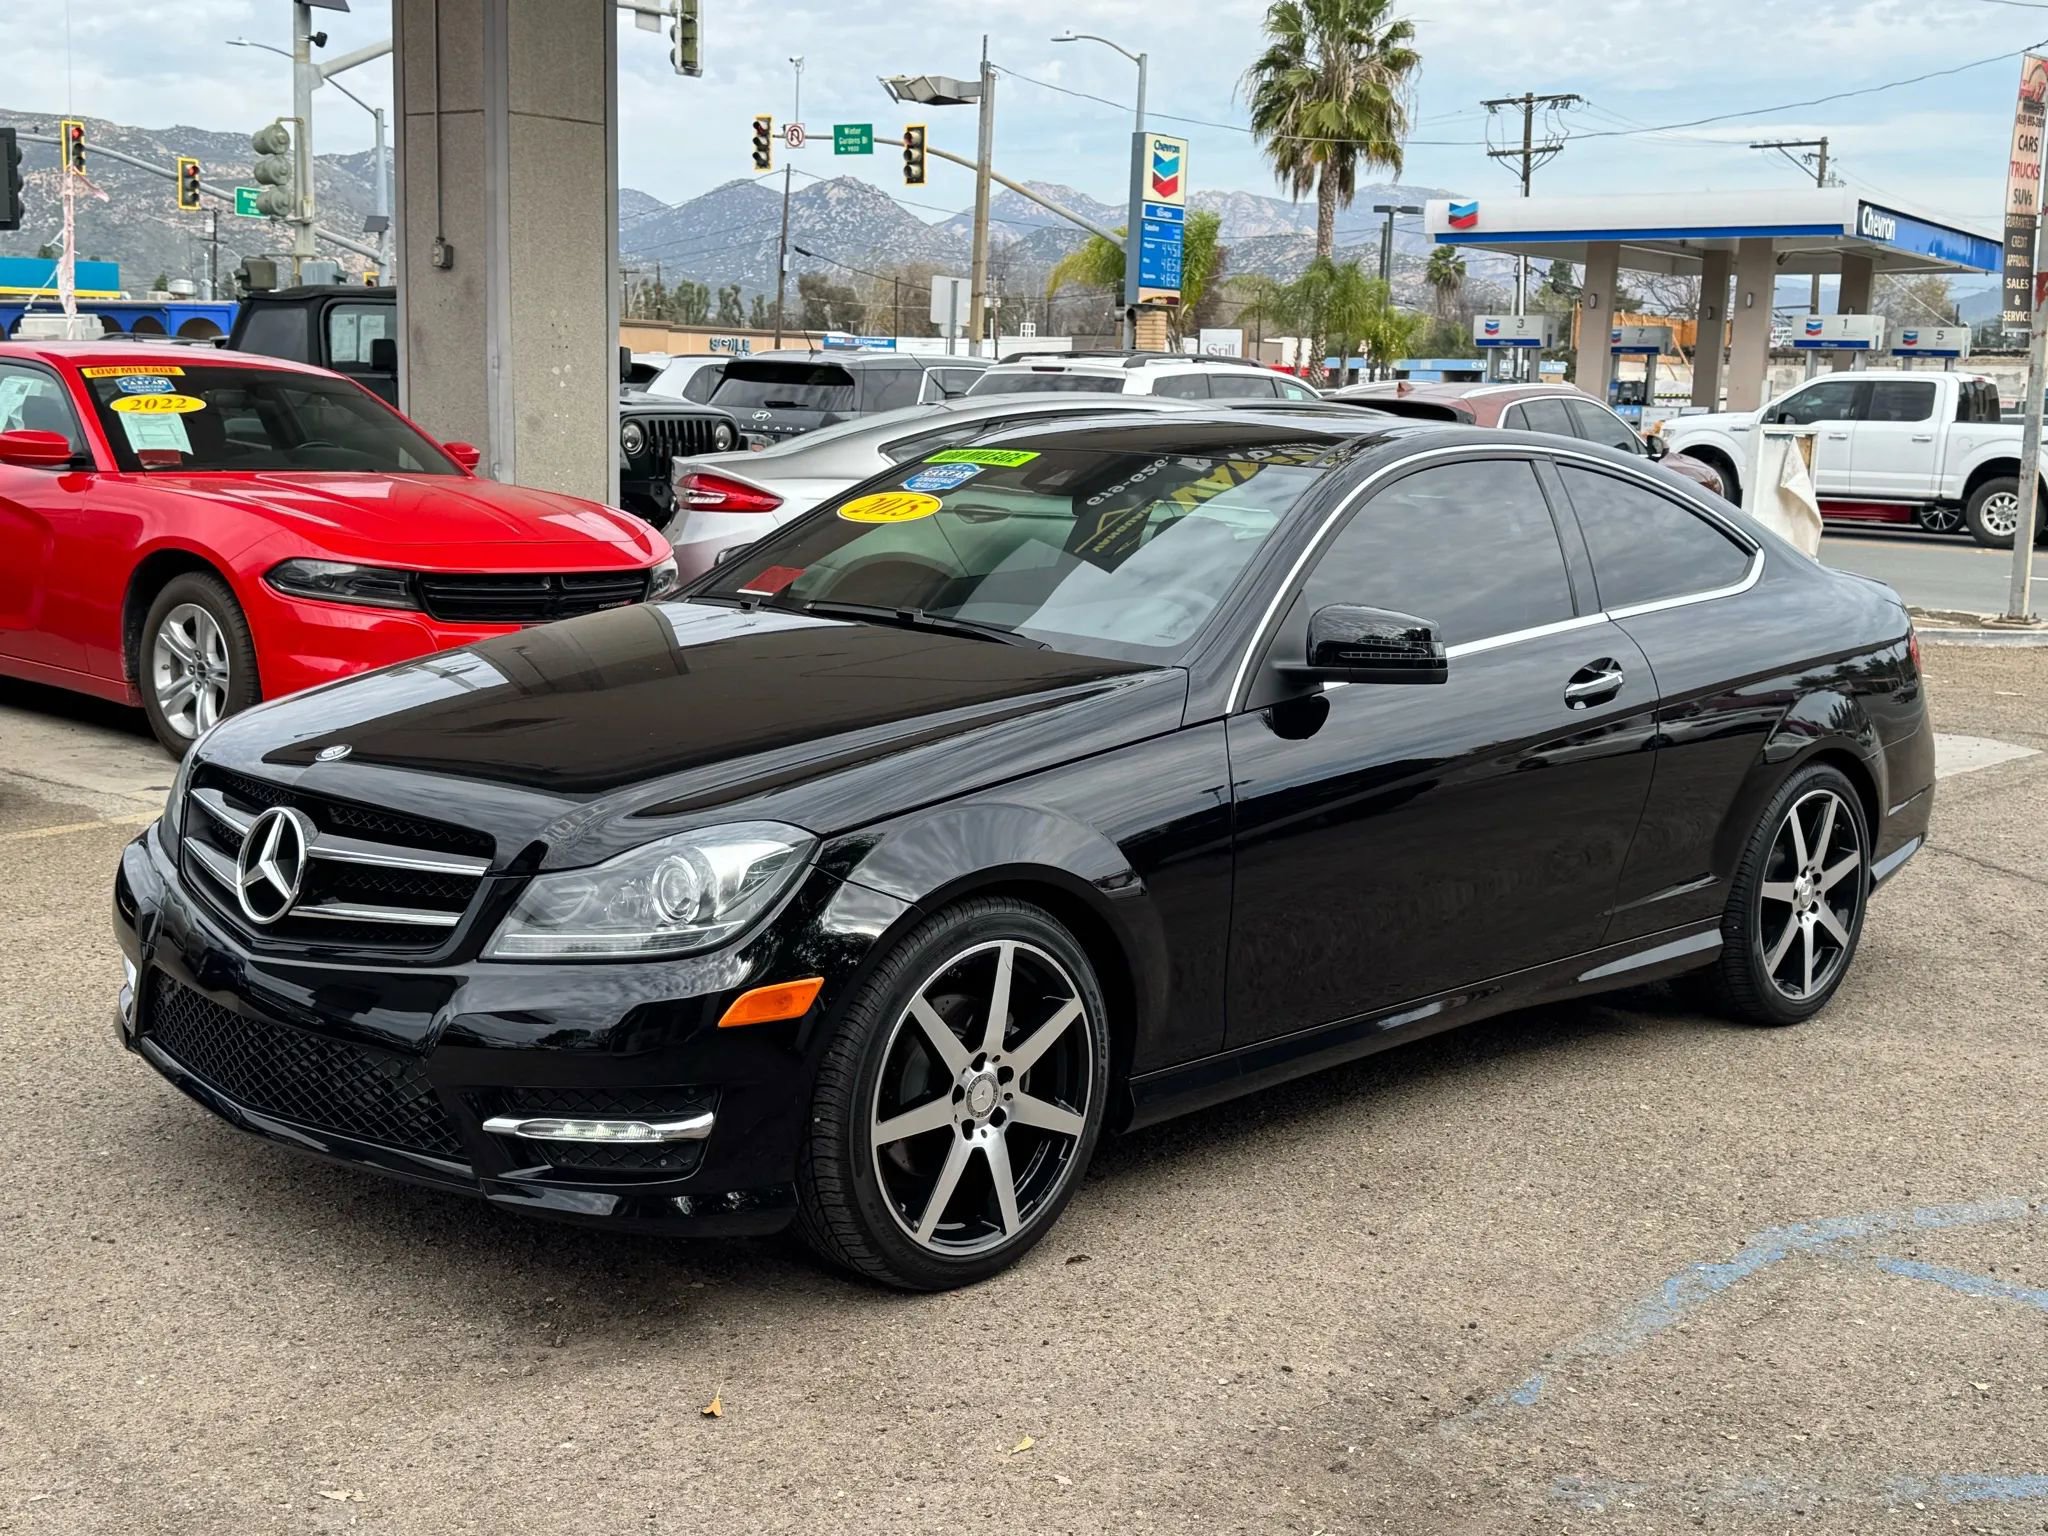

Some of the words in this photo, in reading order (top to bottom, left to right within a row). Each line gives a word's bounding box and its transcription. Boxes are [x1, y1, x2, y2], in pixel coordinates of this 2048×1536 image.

[1153, 139, 1180, 154] Chevron
[2018, 134, 2039, 153] CARS
[2010, 160, 2041, 180] TRUCKS
[2013, 188, 2033, 206] SUVs
[1862, 205, 1896, 241] Chevron
[2011, 235, 2028, 248] CREDIT
[2006, 254, 2030, 268] APPROVAL
[2006, 277, 2030, 289] SALES
[2014, 294, 2021, 305] &
[1517, 318, 1525, 329] 3
[1843, 319, 1848, 329] 1
[1638, 328, 1645, 337] 7
[1936, 330, 1945, 340] 5
[1206, 343, 1235, 356] Grill
[90, 367, 118, 376] LOW
[120, 366, 177, 374] MILEAGE
[129, 397, 187, 411] 2022
[847, 497, 933, 517] 2015
